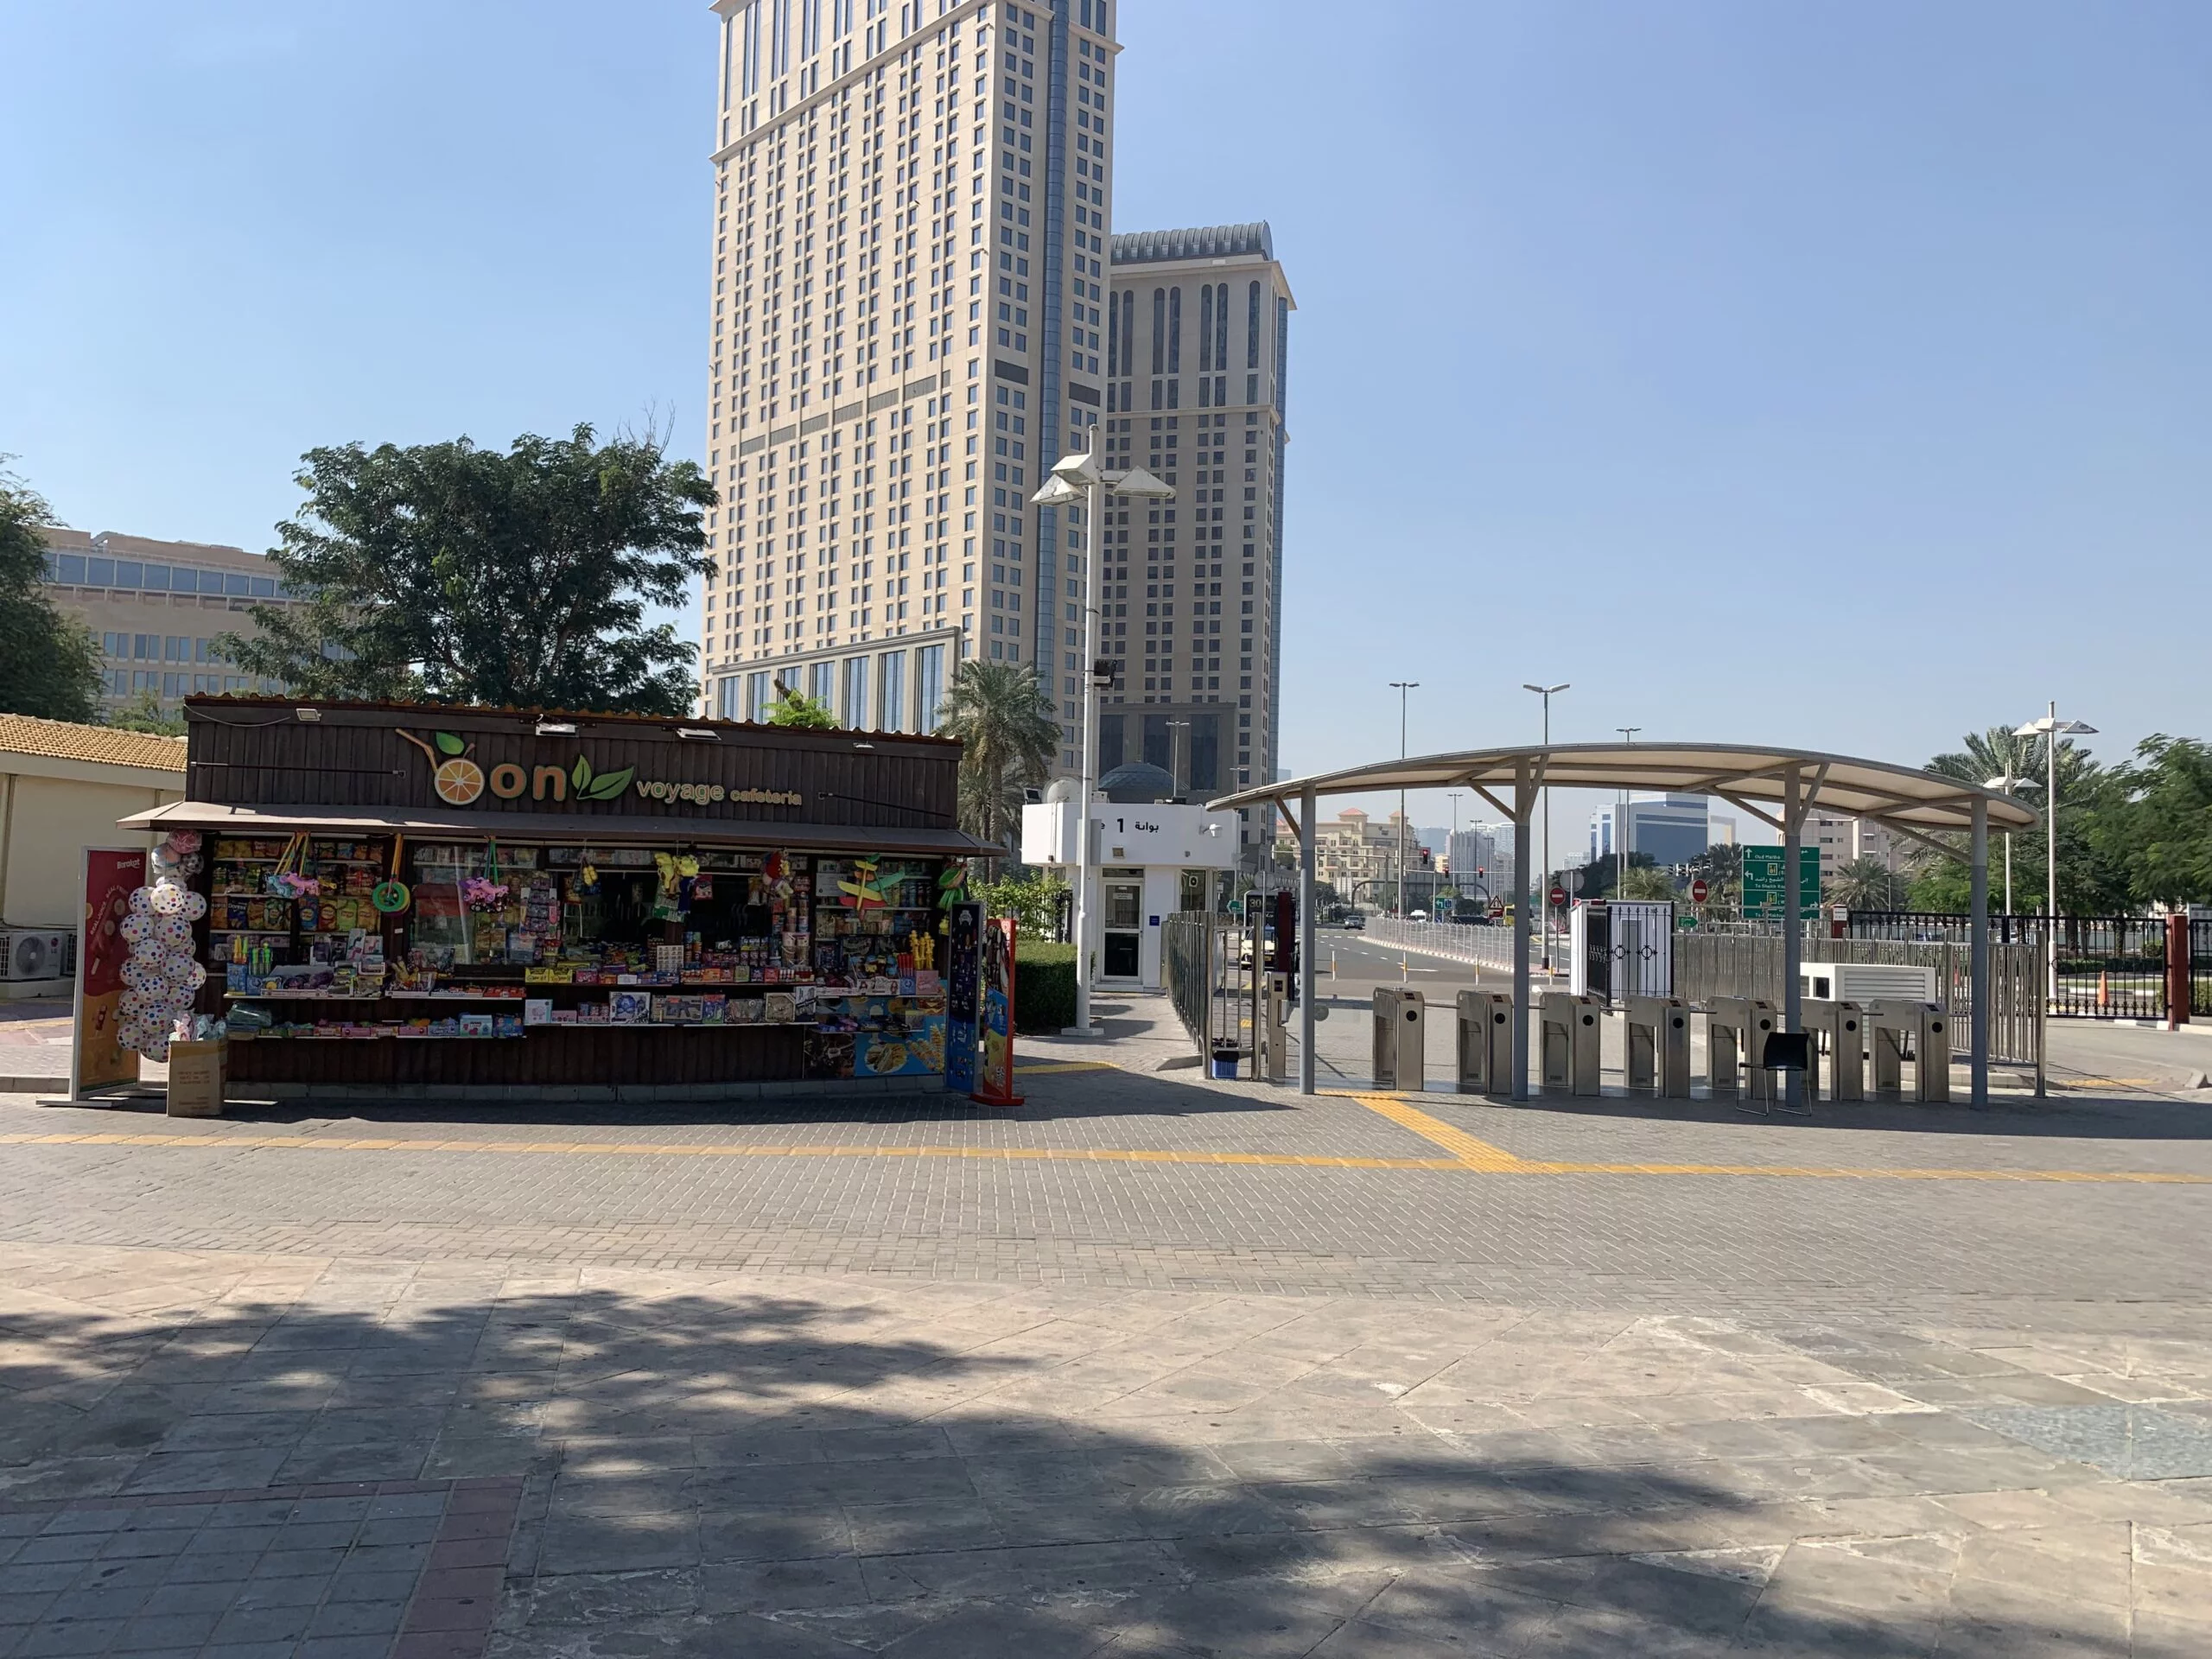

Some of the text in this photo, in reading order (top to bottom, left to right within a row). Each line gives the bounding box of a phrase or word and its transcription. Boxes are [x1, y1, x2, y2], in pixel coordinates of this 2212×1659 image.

[636, 779, 724, 806] voyage
[729, 786, 803, 805] cafeteria
[1116, 817, 1124, 833] 1
[117, 857, 141, 869] Barakat
